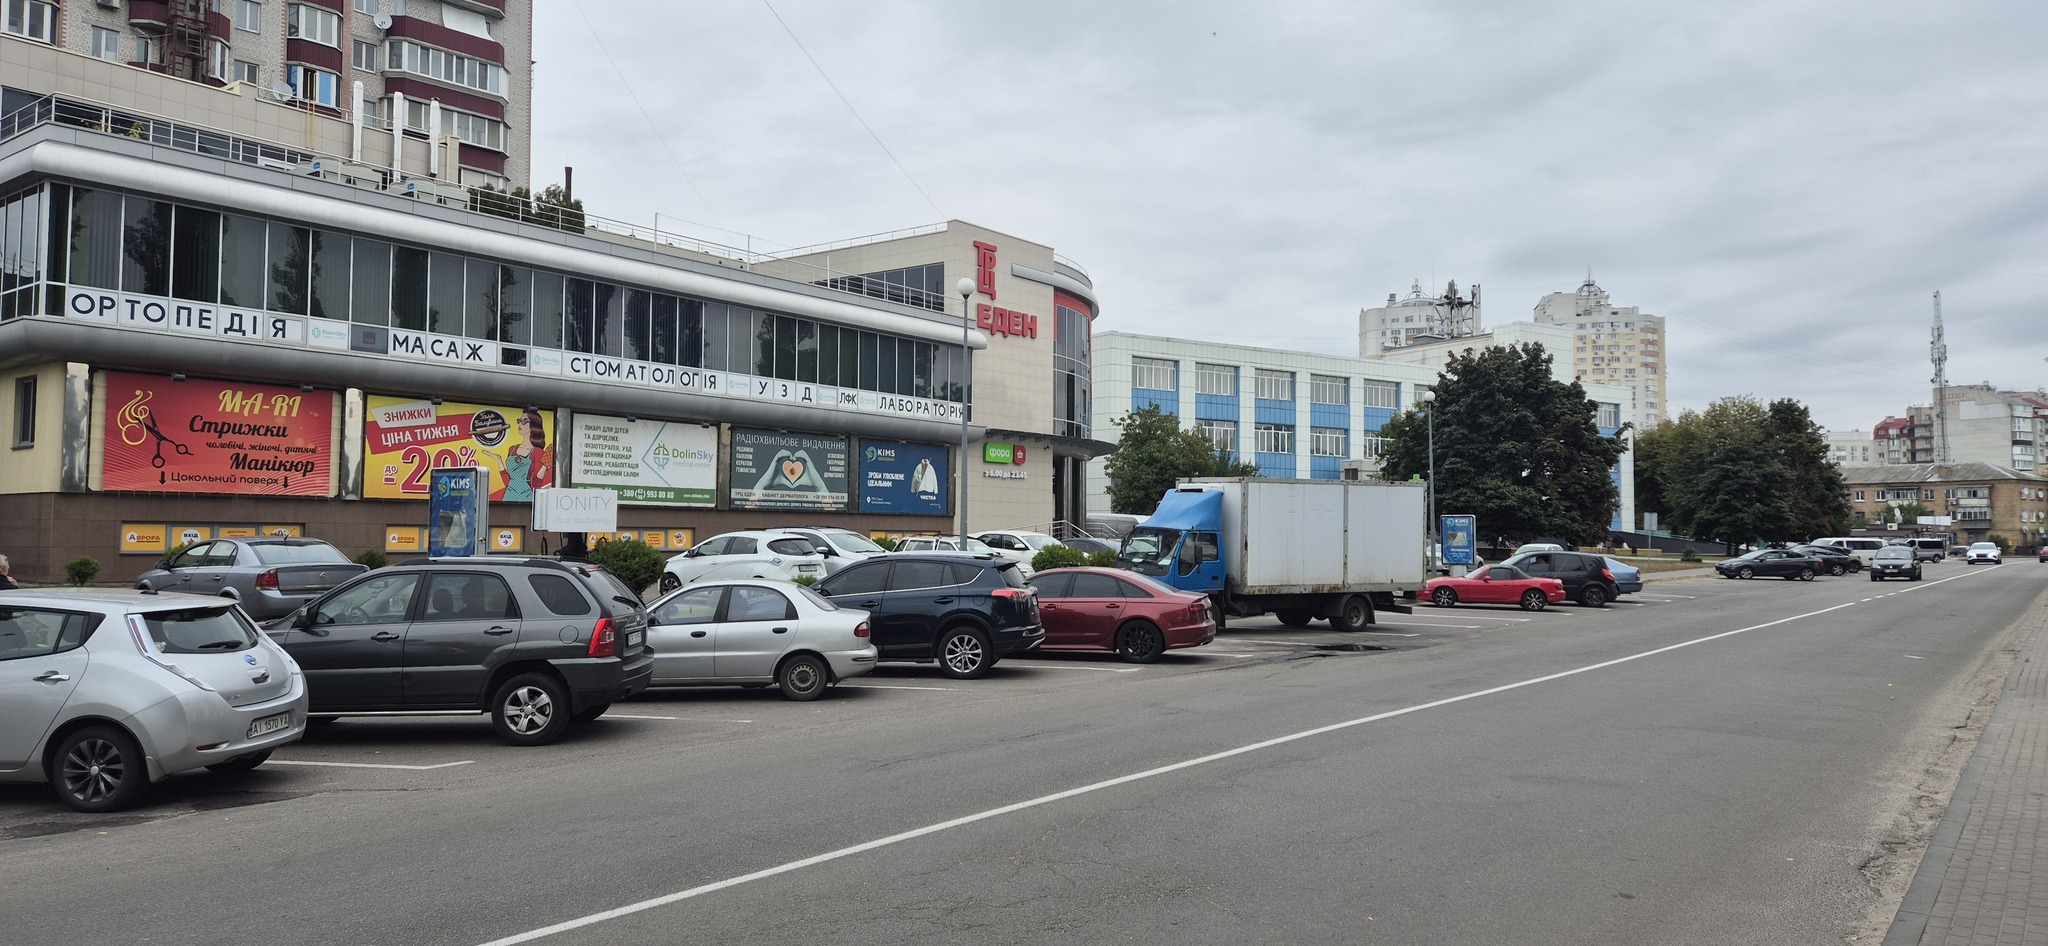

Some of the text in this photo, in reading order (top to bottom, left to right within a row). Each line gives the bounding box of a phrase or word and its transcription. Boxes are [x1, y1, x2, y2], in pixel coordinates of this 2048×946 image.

[973, 240, 998, 300] ТРЦ
[71, 293, 287, 338] ОРТОПЕДІЯ
[976, 302, 1038, 340] ЕДЕН
[392, 333, 484, 362] МАСАЖ
[570, 357, 717, 389] СТОМАТОЛОГІЯ
[218, 389, 301, 418] MA-RI
[839, 392, 857, 405] ЛФК
[384, 407, 432, 423] ЗНИЖКИ
[189, 414, 288, 439] Стрижки
[381, 424, 459, 448] ЦІНА ТИЖНЯ
[736, 433, 846, 451] РАДІОХВИЛЬОВЕ ВИДАЛЕННЯ
[205, 440, 246, 451] чоловічі,
[248, 442, 282, 453] жіночі,
[672, 449, 713, 462] DolinSky
[877, 449, 895, 457] KIMS
[230, 452, 315, 477] Манікюр
[171, 471, 279, 486] Цокольний поверх
[450, 478, 470, 489] KIMS
[556, 495, 612, 511] IONITY
[264, 718, 279, 731] 1570
